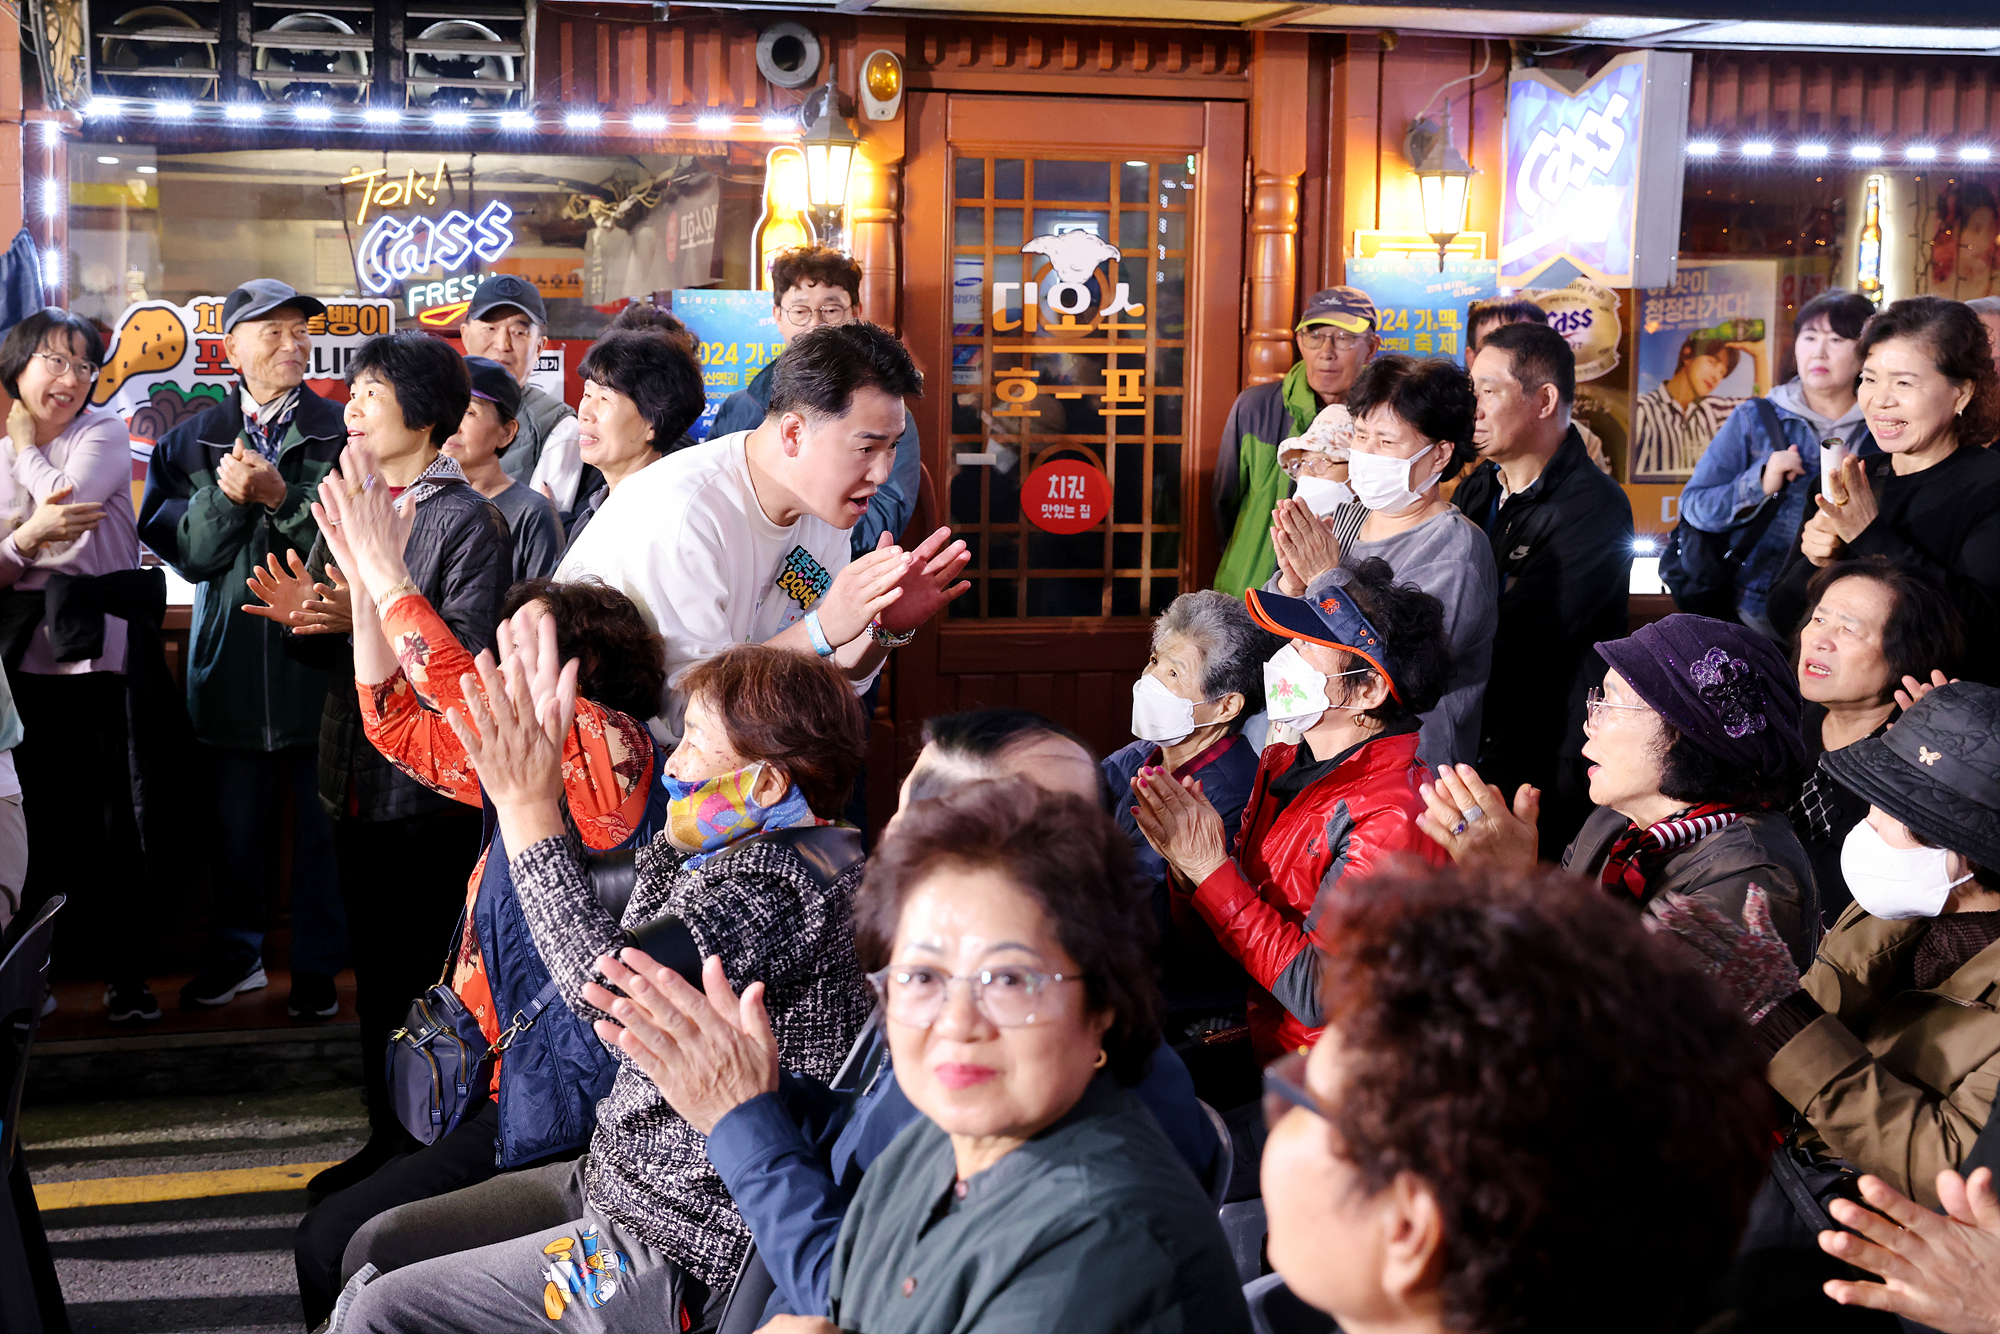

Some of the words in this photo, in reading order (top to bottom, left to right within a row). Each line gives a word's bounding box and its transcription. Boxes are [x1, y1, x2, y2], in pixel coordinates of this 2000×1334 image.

[408, 271, 498, 317] FRES
[992, 281, 1147, 333] 디오스
[1375, 308, 1410, 332] 024
[697, 341, 740, 366] 024
[1047, 473, 1086, 500] 치킨
[1041, 503, 1076, 520] 맛있는
[1079, 503, 1091, 520] 집
[778, 570, 818, 610] 오언석
